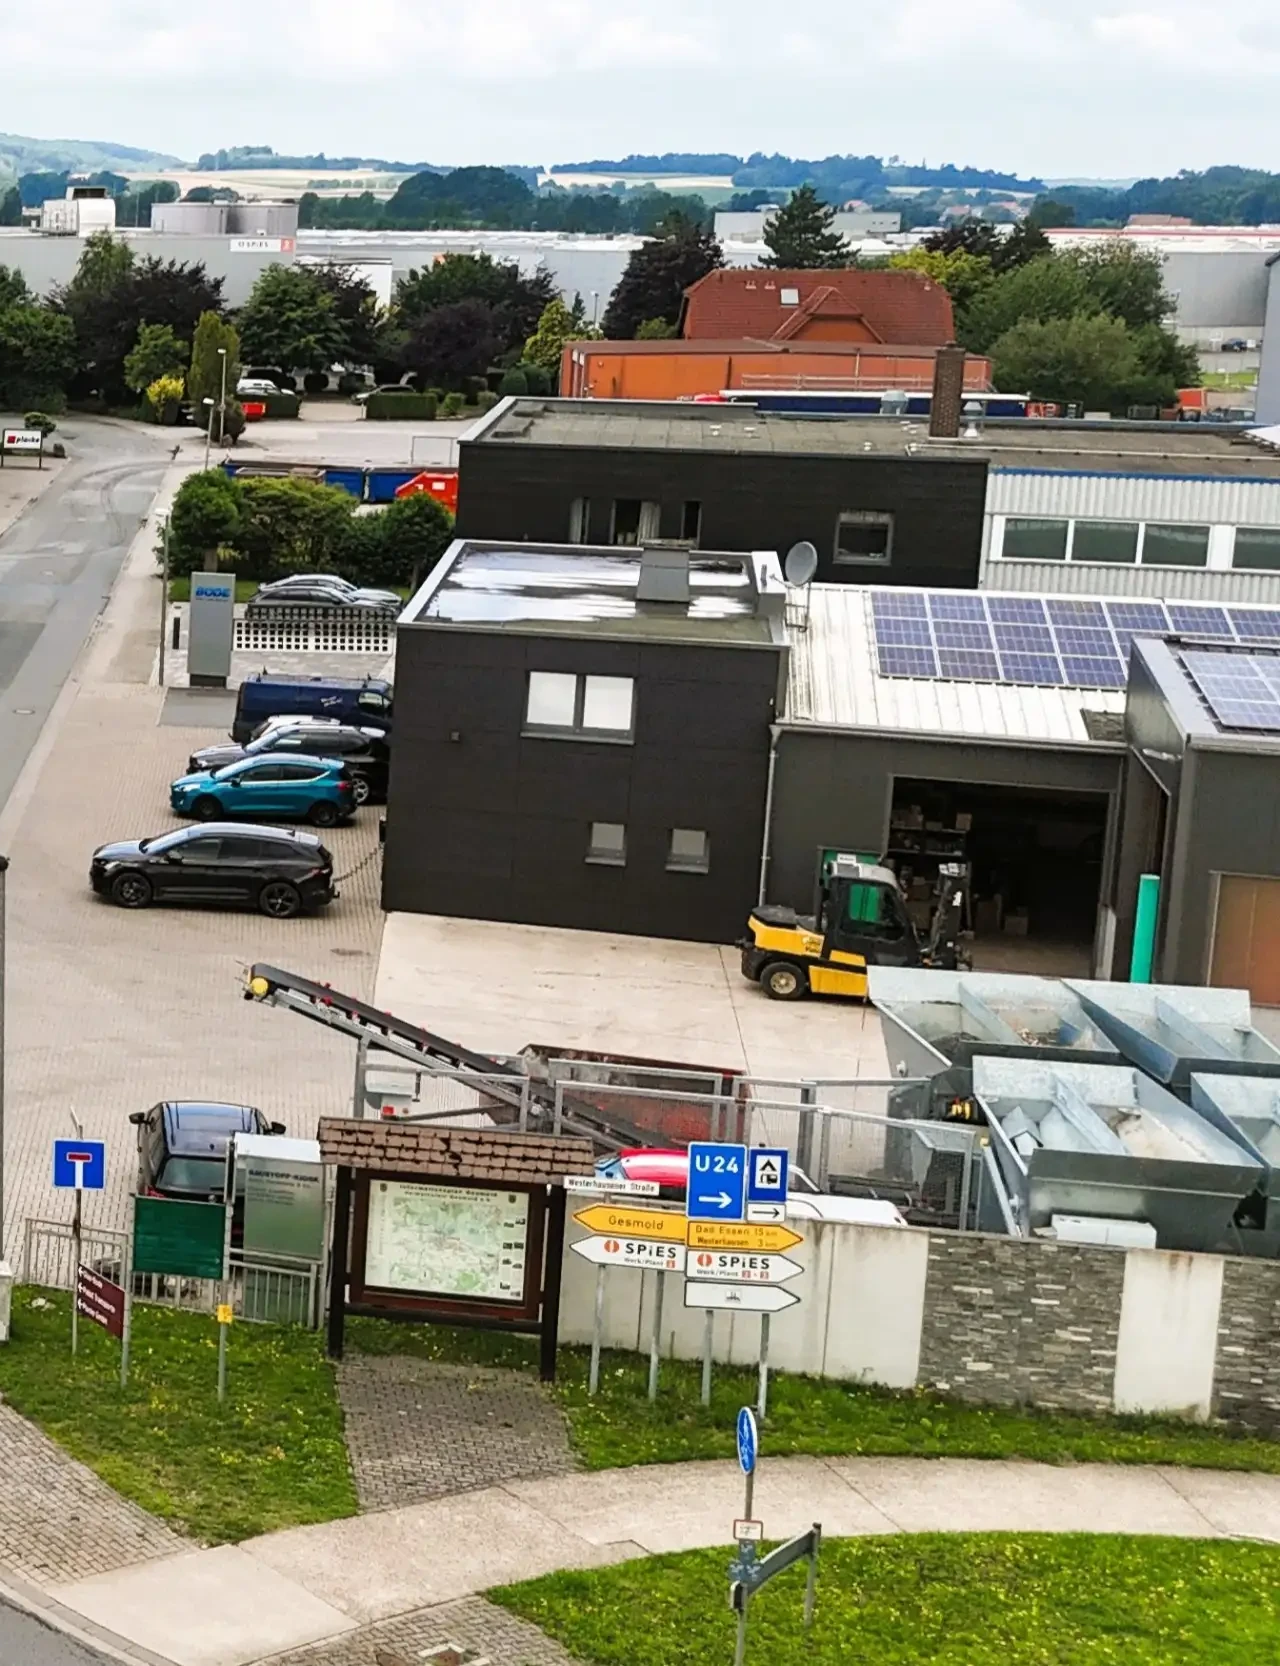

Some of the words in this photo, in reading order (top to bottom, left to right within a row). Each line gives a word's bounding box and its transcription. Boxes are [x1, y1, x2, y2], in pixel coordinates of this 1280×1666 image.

[631, 1182, 656, 1192] Straße
[608, 1215, 665, 1231] Gesmold
[719, 1226, 751, 1236] Essen
